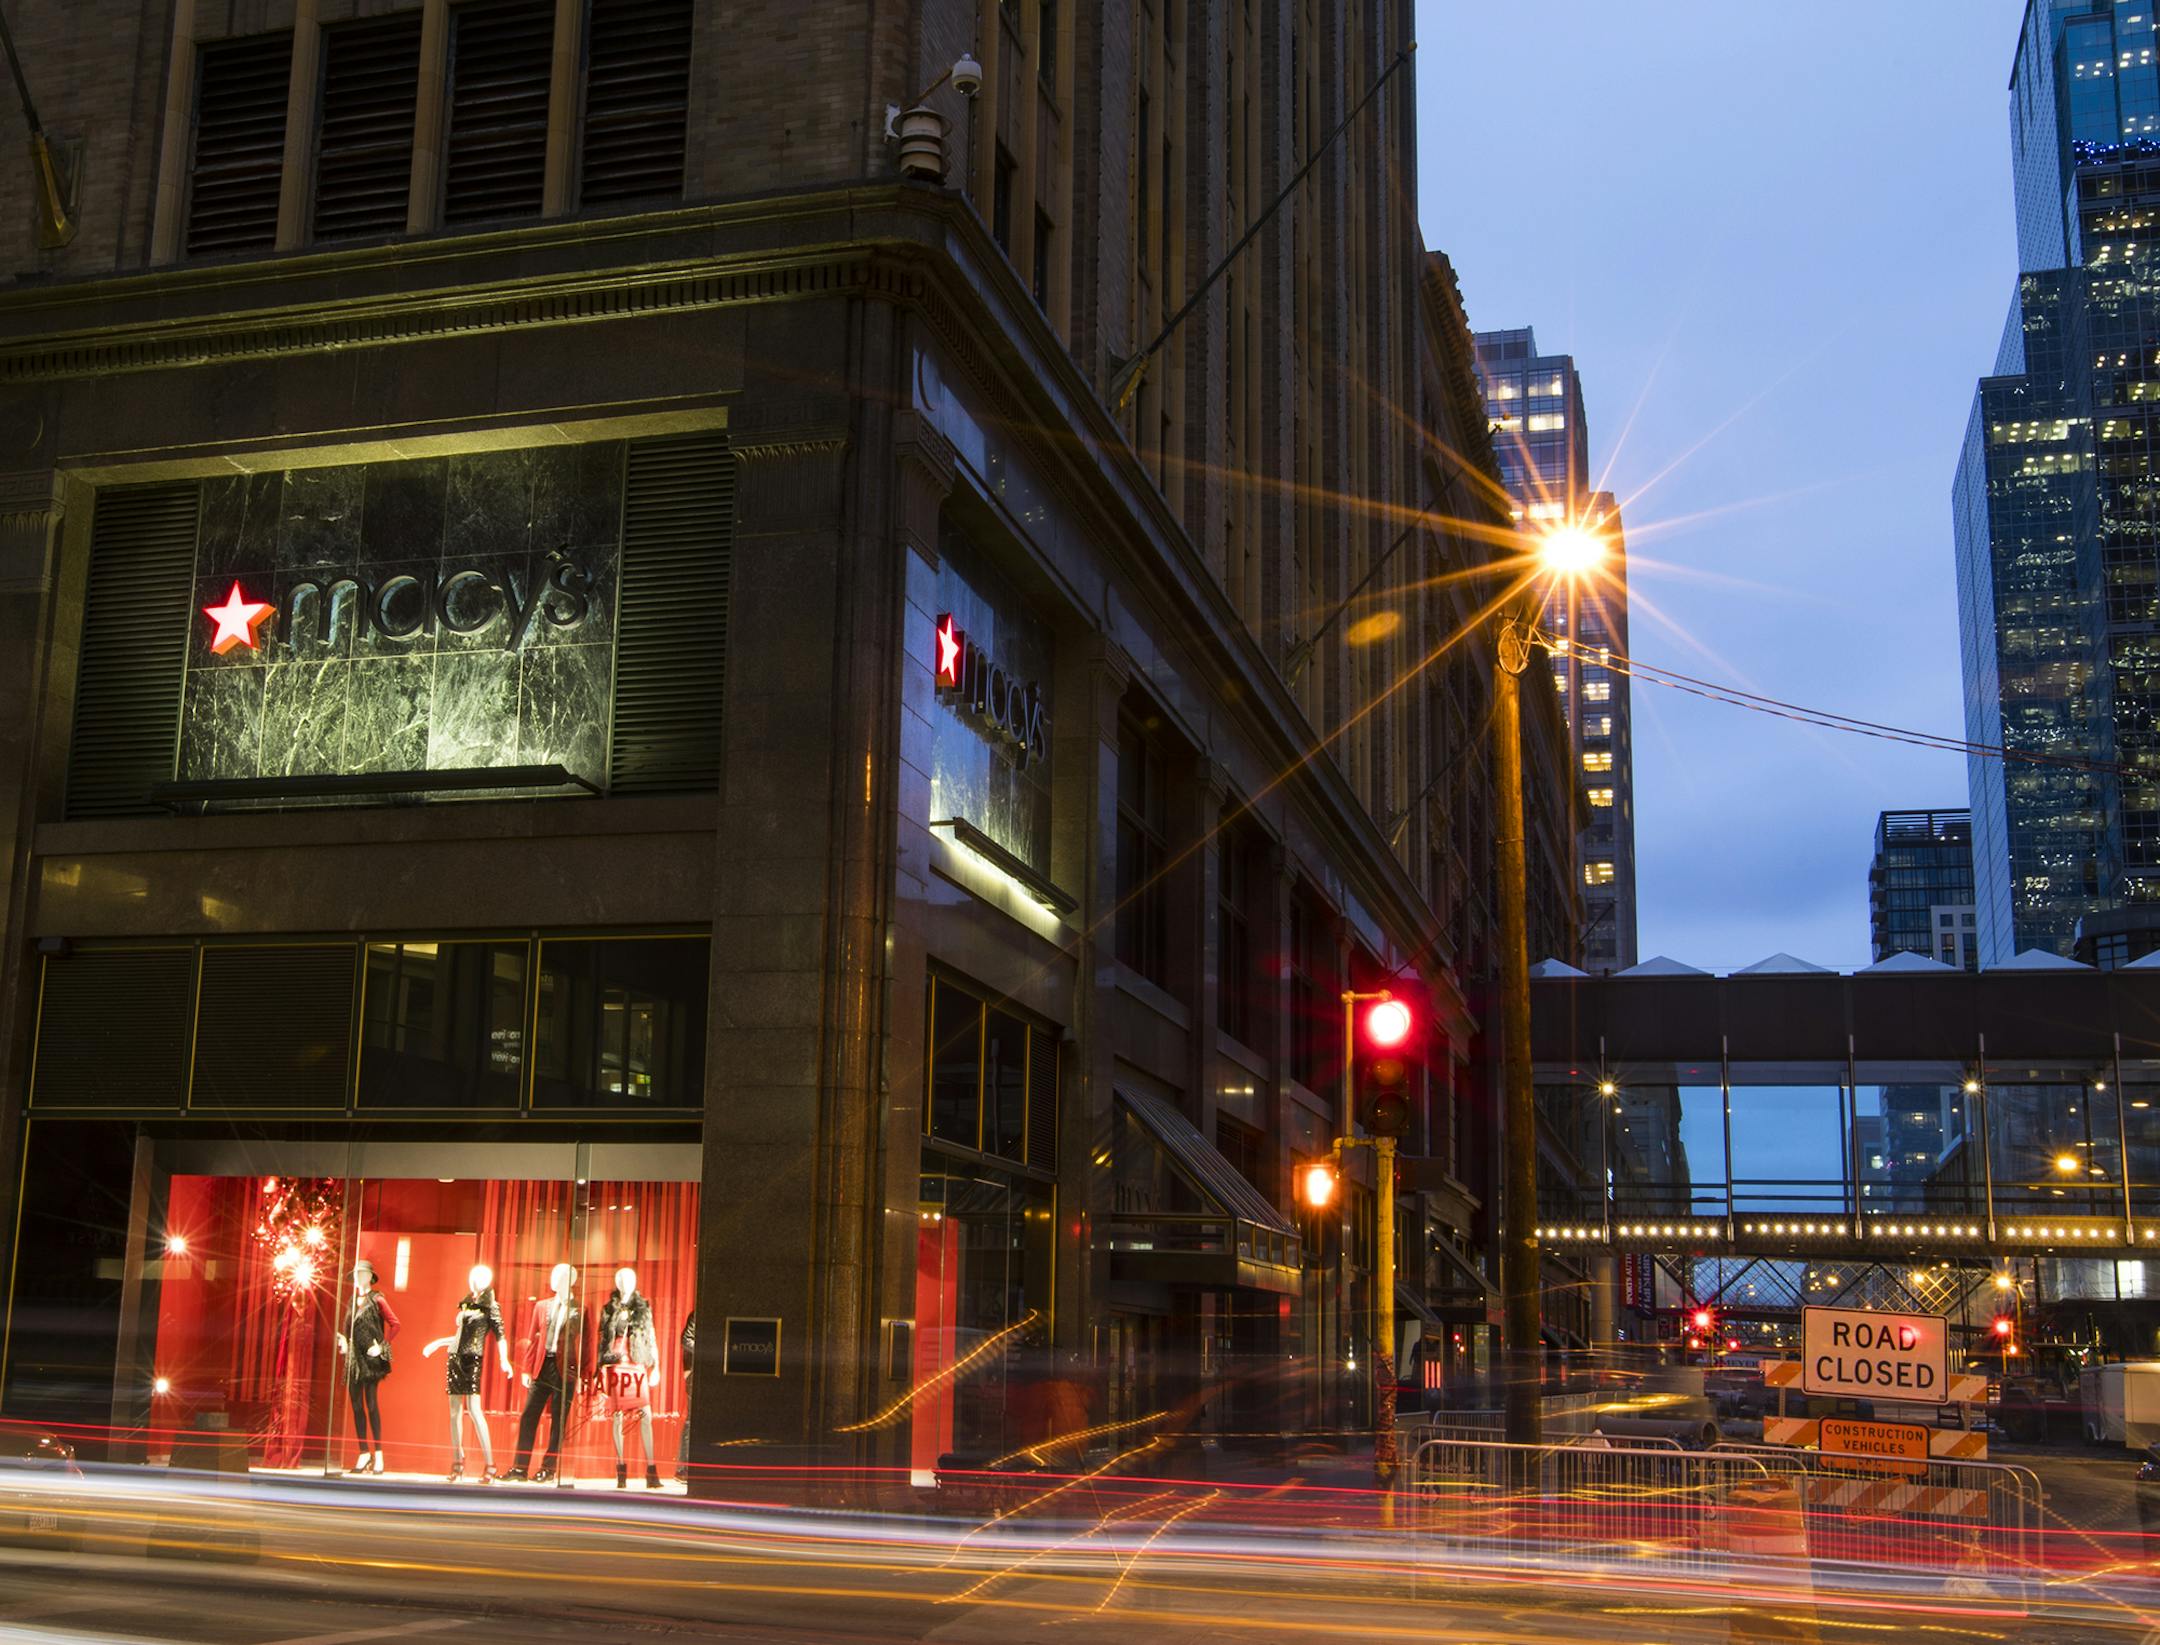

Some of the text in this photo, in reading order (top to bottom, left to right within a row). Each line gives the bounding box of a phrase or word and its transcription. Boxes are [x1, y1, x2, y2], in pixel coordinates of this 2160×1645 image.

[277, 545, 592, 653] macy's
[1833, 1321, 1917, 1351] ROAD
[580, 1371, 645, 1398] HAPPY
[1816, 1355, 1935, 1389] CLOSED
[1825, 1423, 1923, 1441] CONSTRUCTION
[1843, 1439, 1905, 1454] VEHICLES
